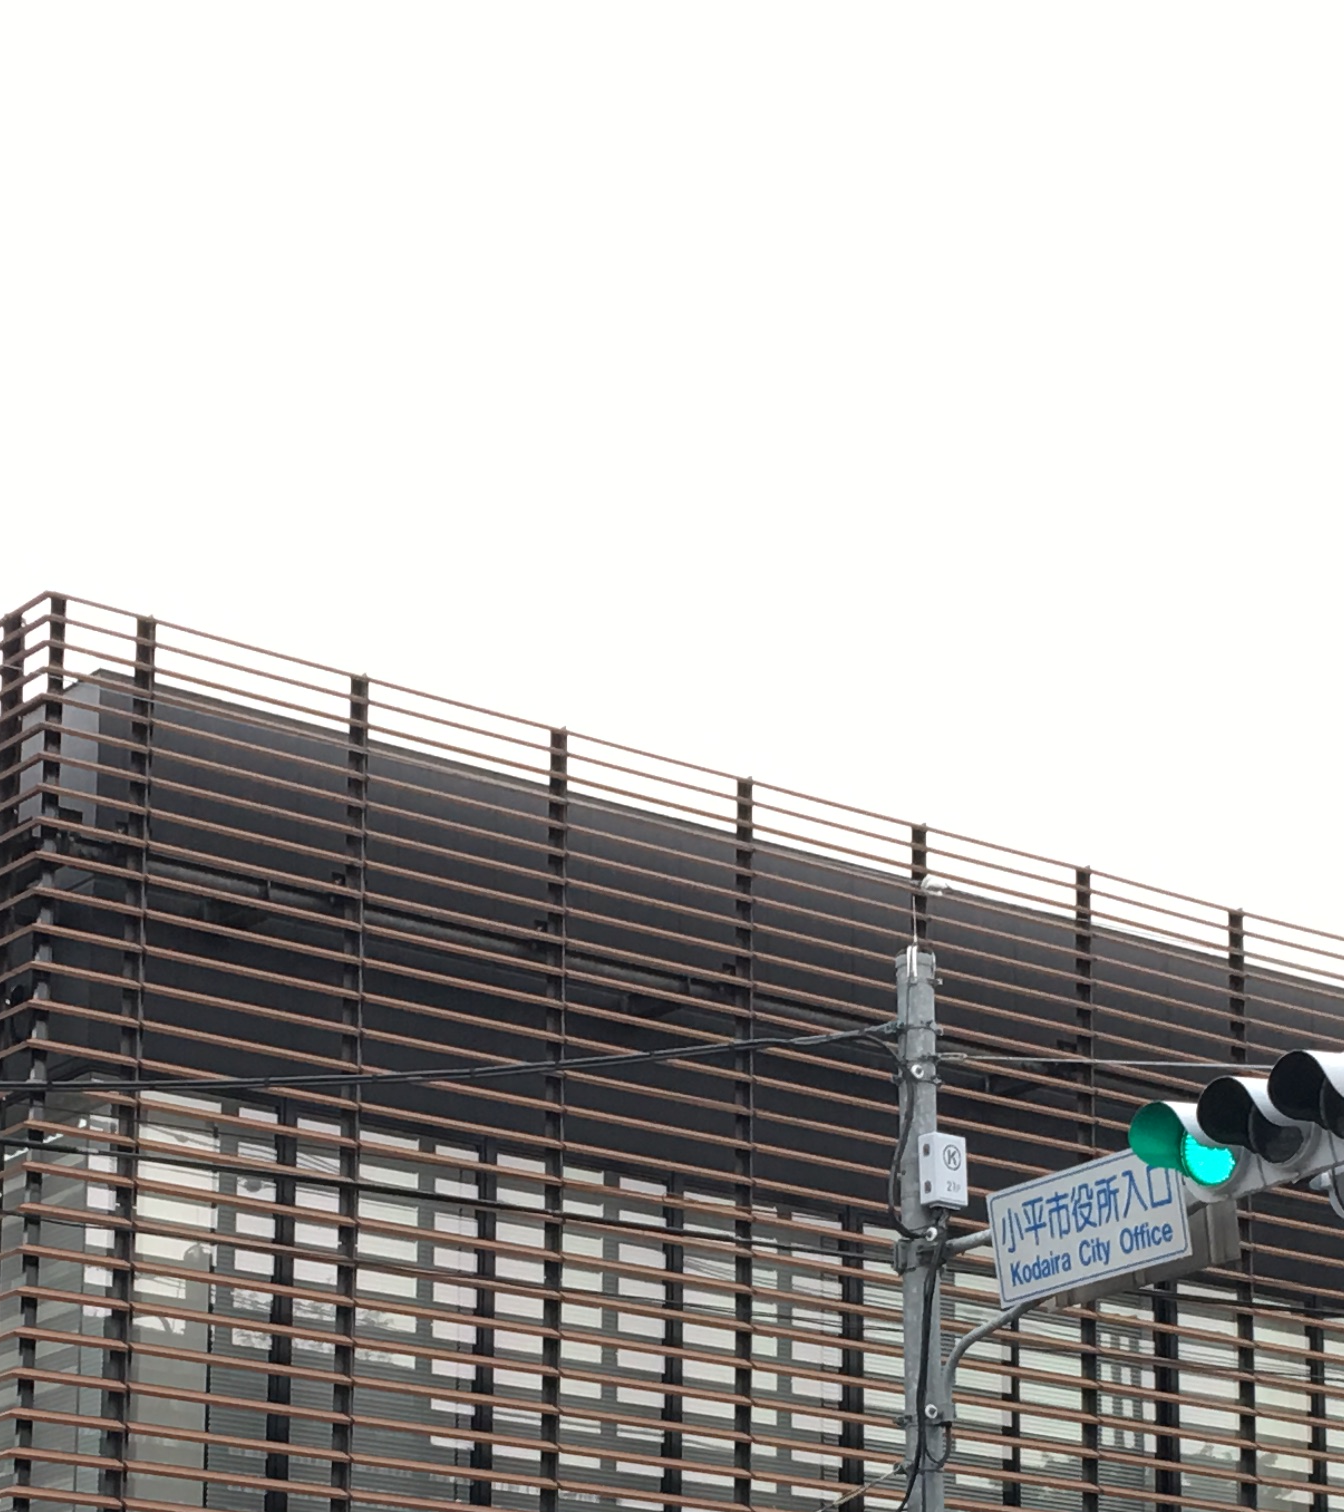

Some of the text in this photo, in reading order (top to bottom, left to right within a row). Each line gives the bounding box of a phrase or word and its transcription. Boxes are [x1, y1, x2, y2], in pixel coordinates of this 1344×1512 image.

[1001, 1166, 1173, 1254] 小平市役所入口
[1010, 1220, 1174, 1287] Kodaira City Office
